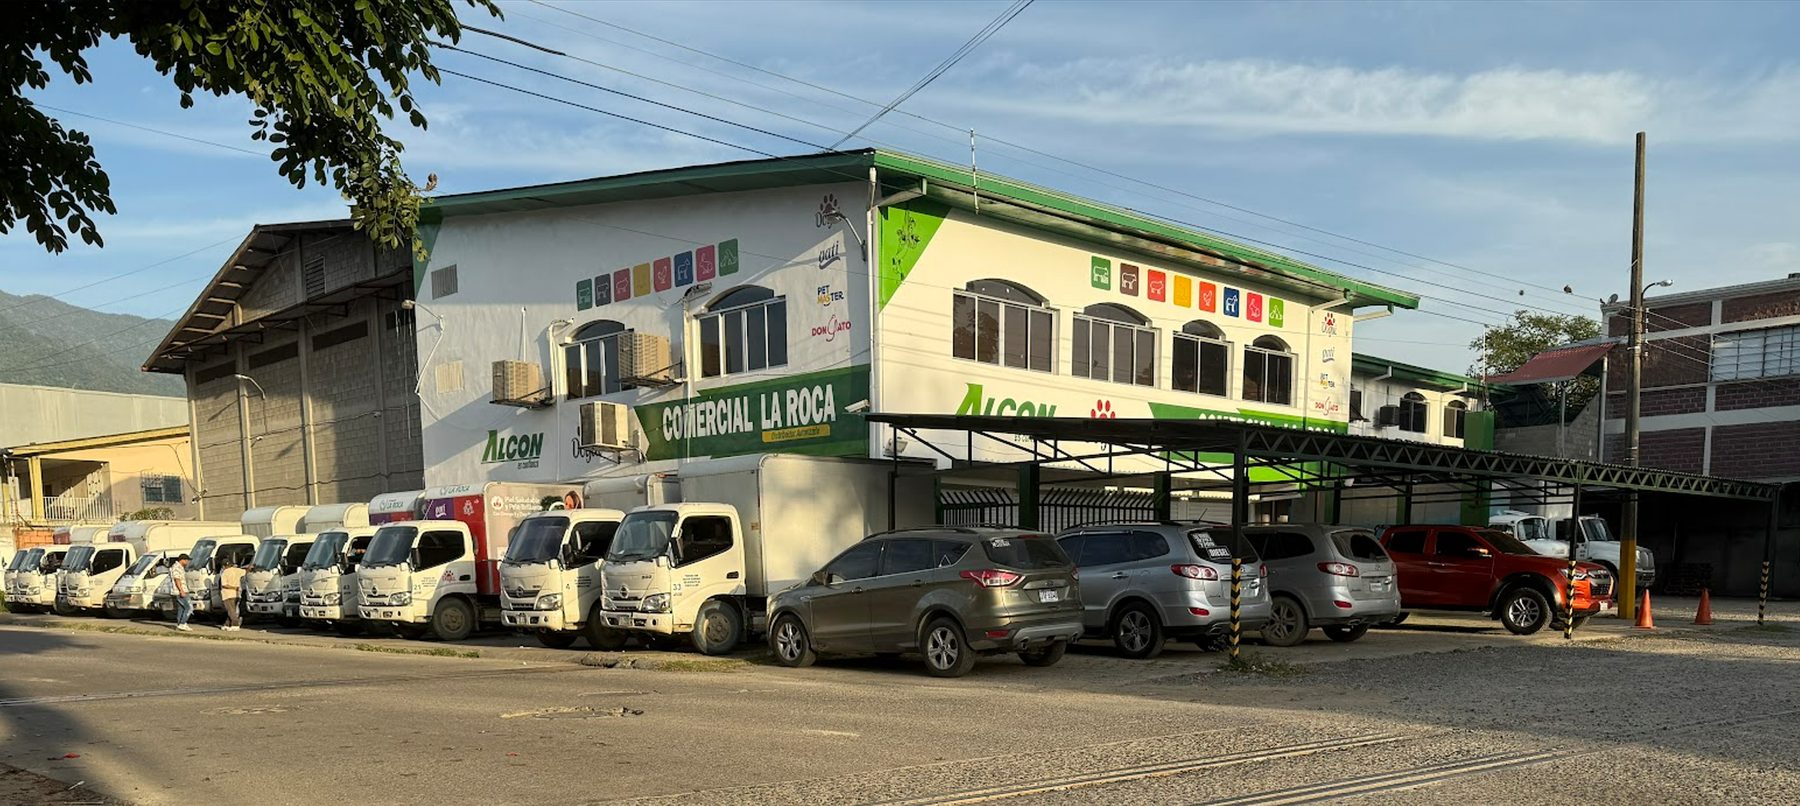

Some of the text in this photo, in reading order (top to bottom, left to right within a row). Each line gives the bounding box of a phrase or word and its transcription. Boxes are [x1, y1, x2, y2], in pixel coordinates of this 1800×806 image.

[817, 284, 830, 296] PET
[662, 384, 836, 441] COMERCIAL LA ROCA
[481, 429, 544, 461] ALCON
